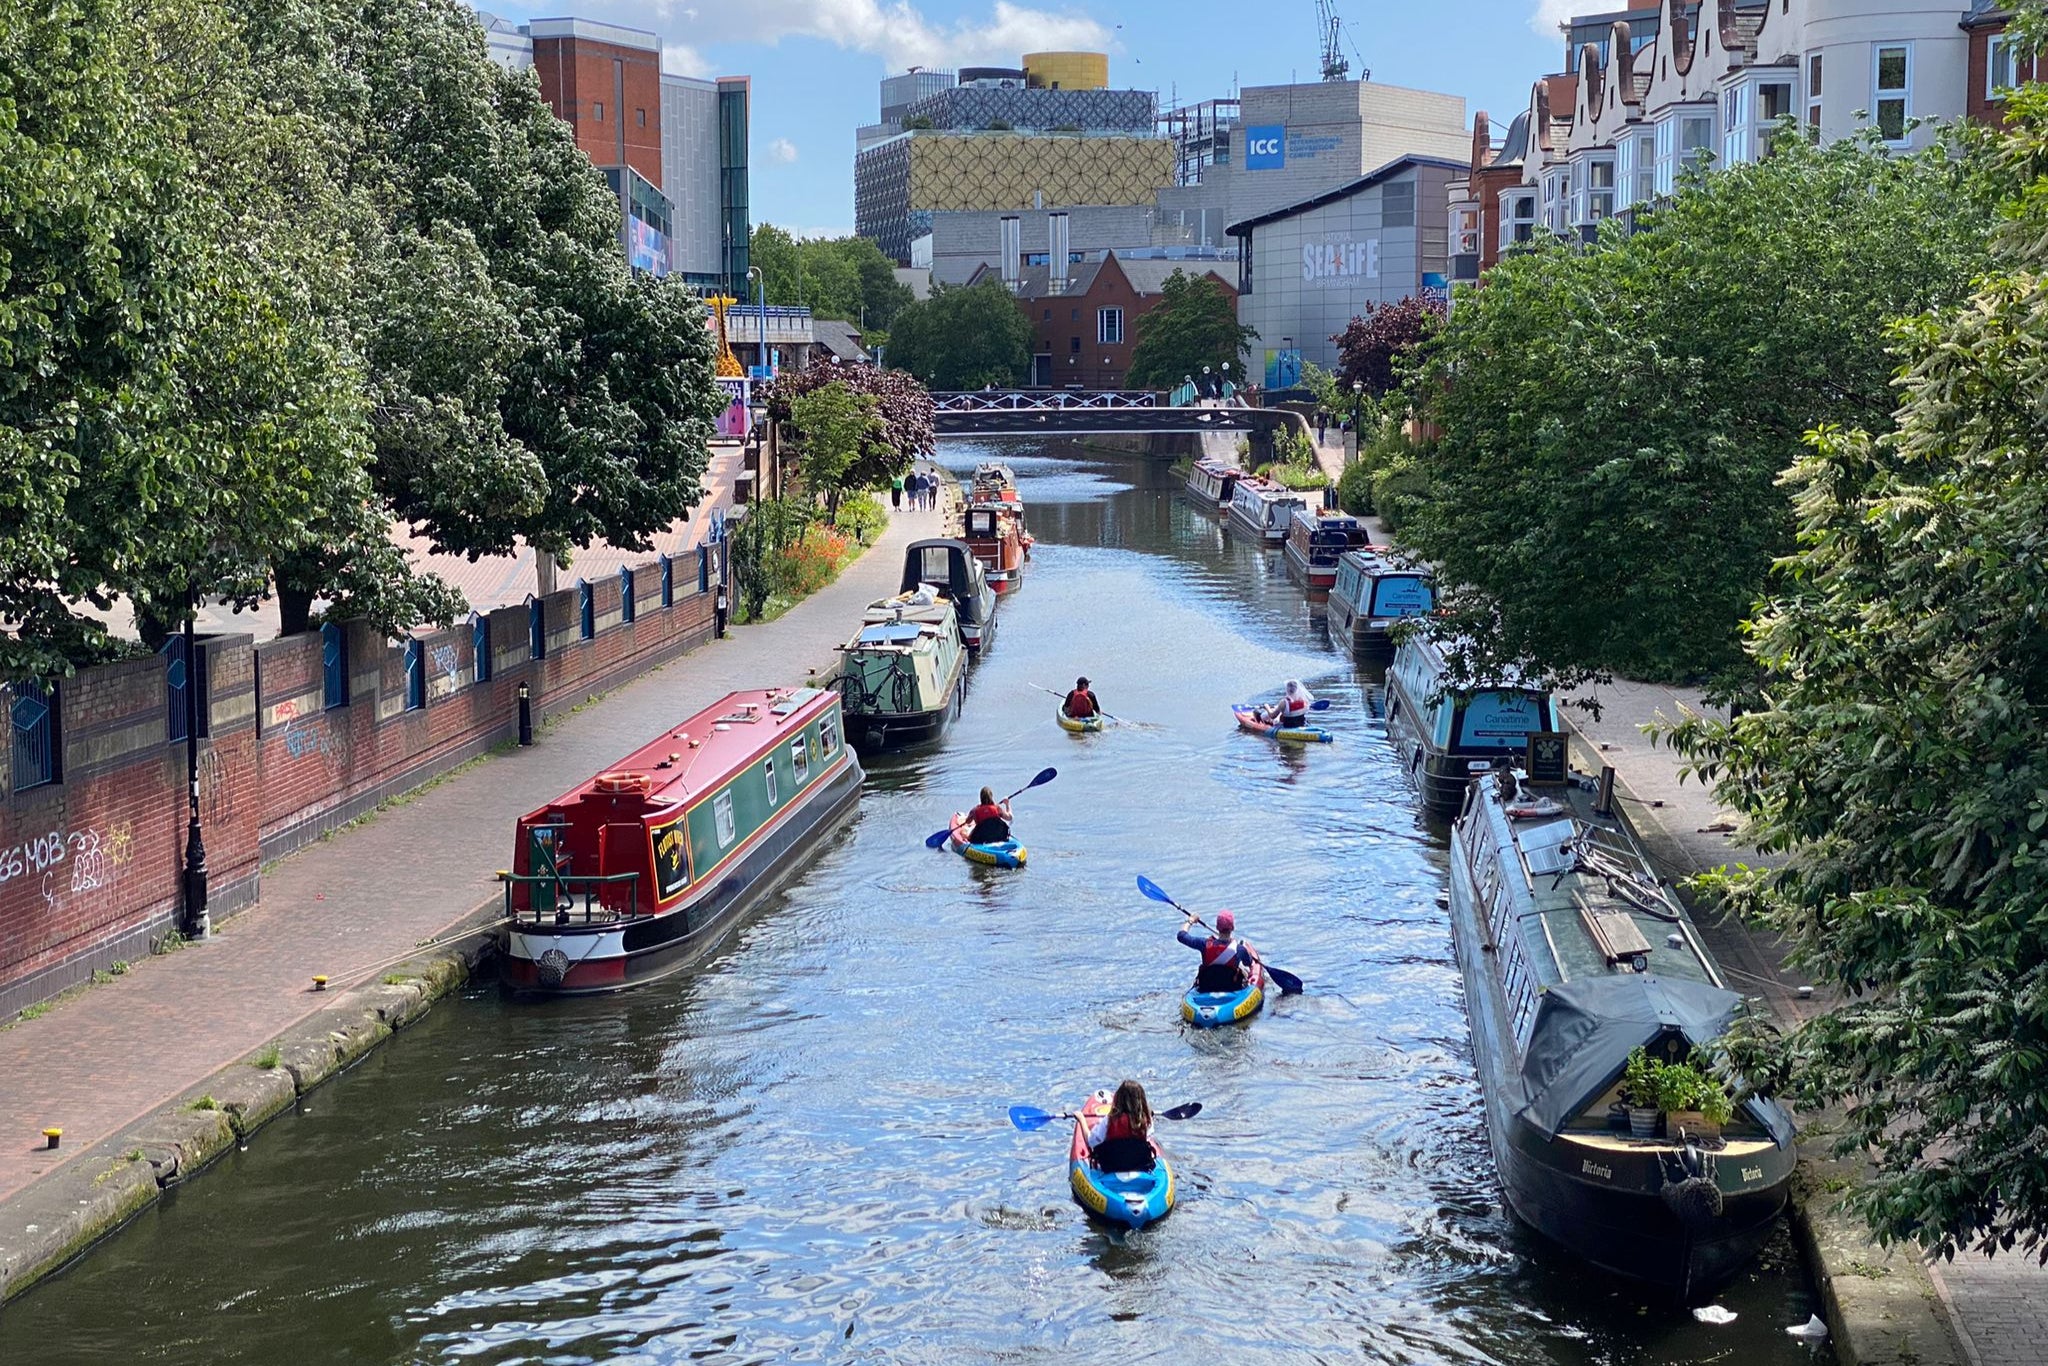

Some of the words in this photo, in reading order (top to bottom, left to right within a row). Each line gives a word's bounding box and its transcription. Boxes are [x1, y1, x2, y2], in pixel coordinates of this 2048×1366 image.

[1250, 139, 1278, 154] ICC
[1322, 232, 1352, 242] NATIONAL
[1303, 242, 1335, 281] SEA
[1316, 276, 1360, 288] BIRMINGHAM
[1485, 713, 1530, 724] Canaltime
[25, 832, 65, 876] MOB
[1582, 1160, 1612, 1179] Victoria
[1741, 1165, 1762, 1181] Victoria
